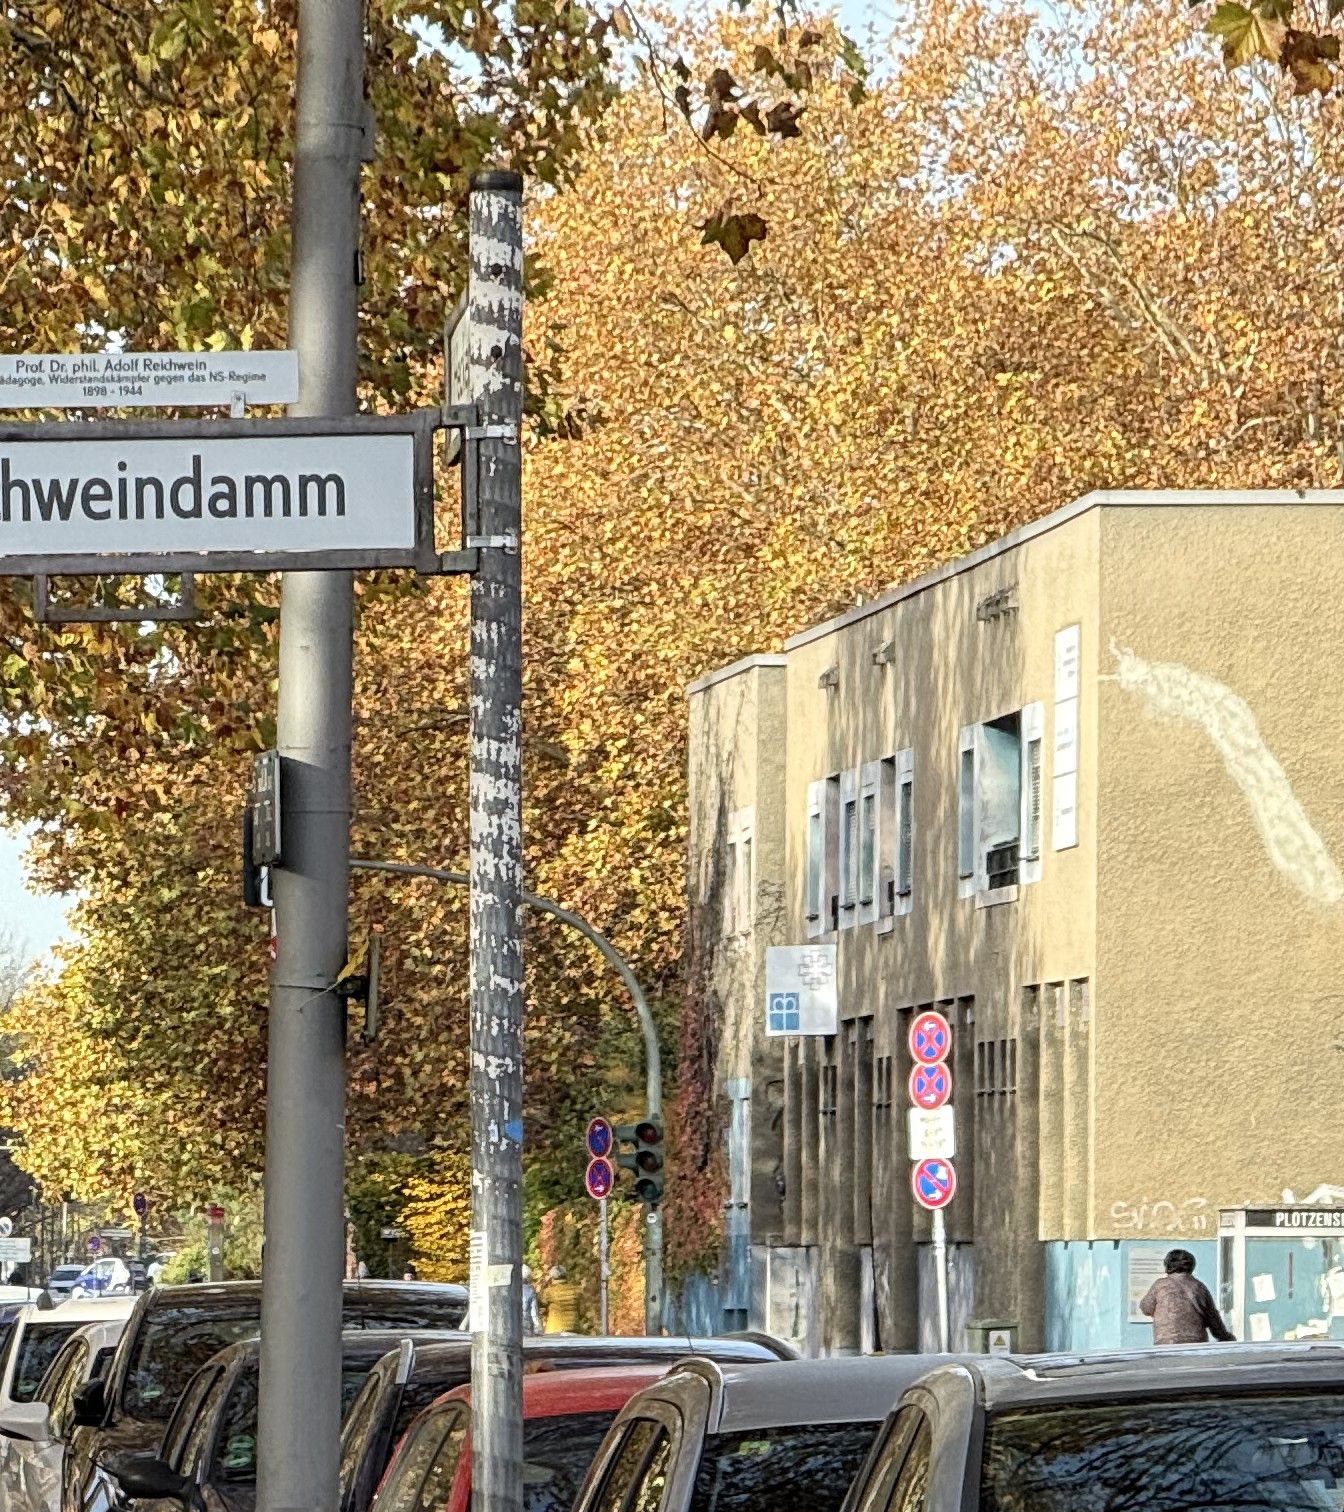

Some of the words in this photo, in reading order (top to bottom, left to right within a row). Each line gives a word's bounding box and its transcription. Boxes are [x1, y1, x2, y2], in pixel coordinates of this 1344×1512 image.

[15, 359, 45, 374] Prof.
[49, 359, 68, 373] Dr.
[72, 358, 100, 375] phil.
[104, 358, 139, 372] Adolf
[143, 357, 207, 372] Reichwein
[48, 372, 151, 385] Widerstandskämpfer
[154, 373, 185, 385] gegen
[187, 371, 207, 383] das
[209, 370, 267, 385] NS-Regime
[82, 385, 107, 397] 1898
[118, 384, 143, 396] 1944
